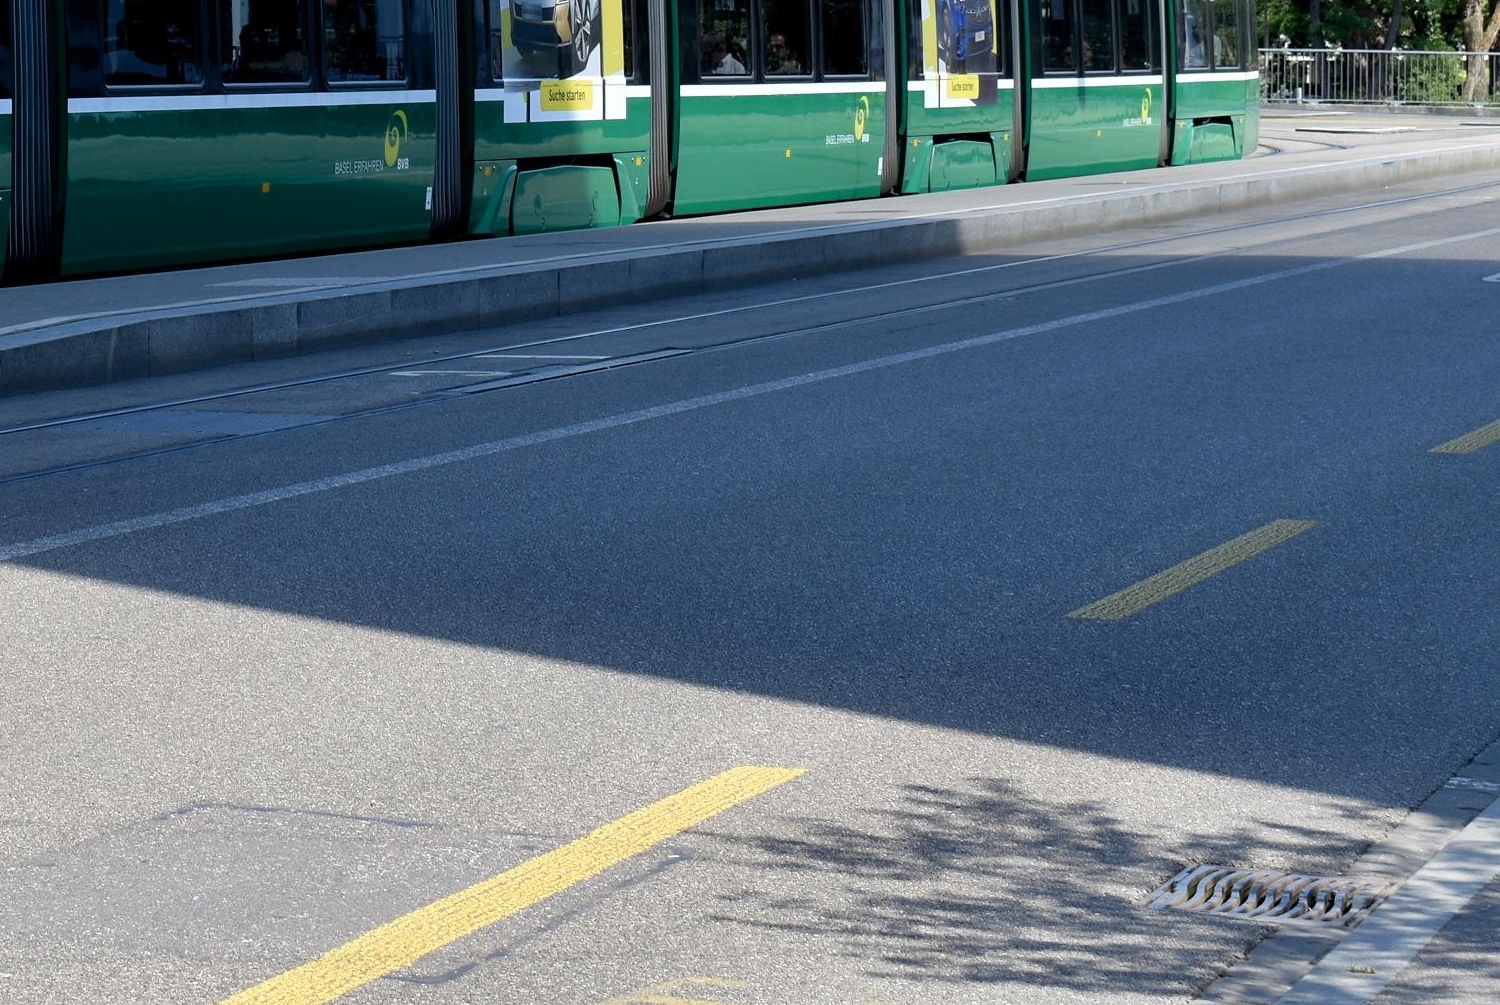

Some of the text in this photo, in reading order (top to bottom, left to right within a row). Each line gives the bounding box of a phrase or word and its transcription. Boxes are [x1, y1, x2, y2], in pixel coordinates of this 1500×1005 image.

[549, 89, 585, 101] Suche starten
[335, 159, 384, 174] BASEL ERFAHREN
[397, 158, 409, 170] BVB
